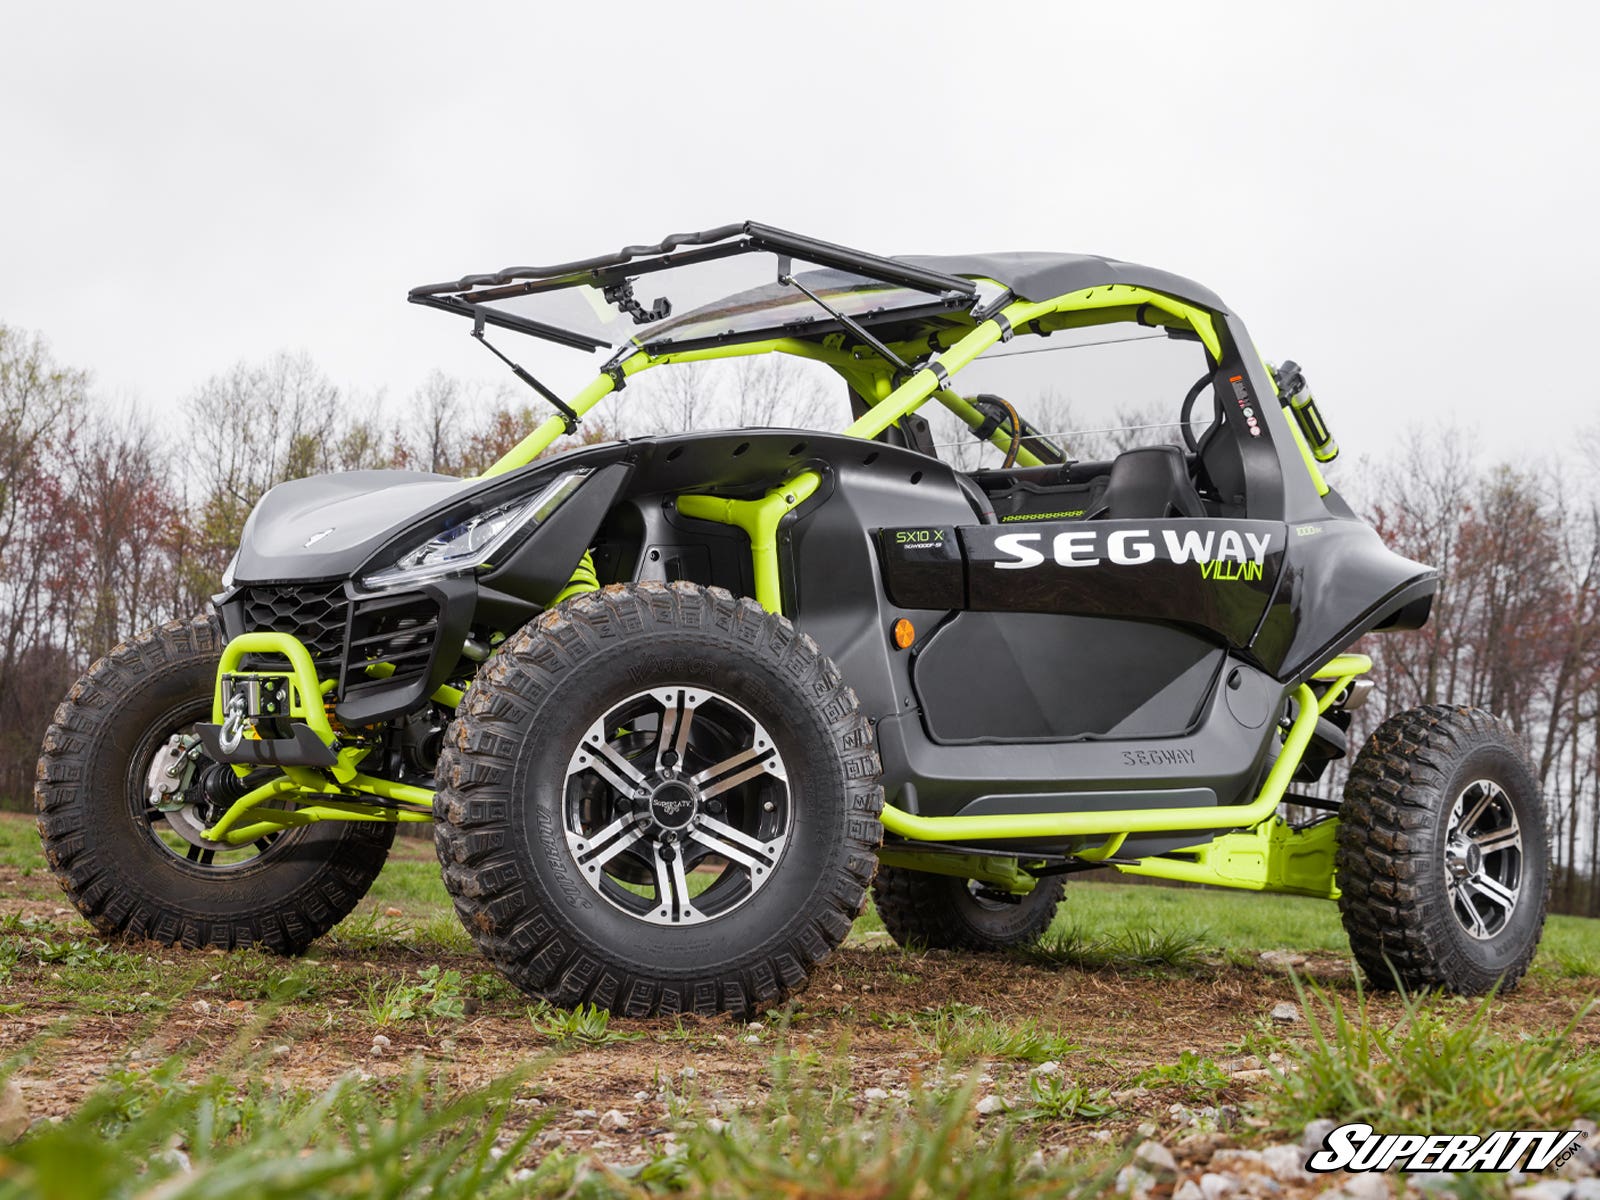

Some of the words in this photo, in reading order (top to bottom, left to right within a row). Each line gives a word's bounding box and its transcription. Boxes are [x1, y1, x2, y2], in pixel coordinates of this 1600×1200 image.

[896, 530, 929, 543] SX10
[933, 530, 944, 541] X
[993, 529, 1272, 569] SEGWAY
[1200, 559, 1263, 581] VILLAIN
[1121, 748, 1196, 767] SEGWAY
[536, 803, 593, 910] SUPERATV
